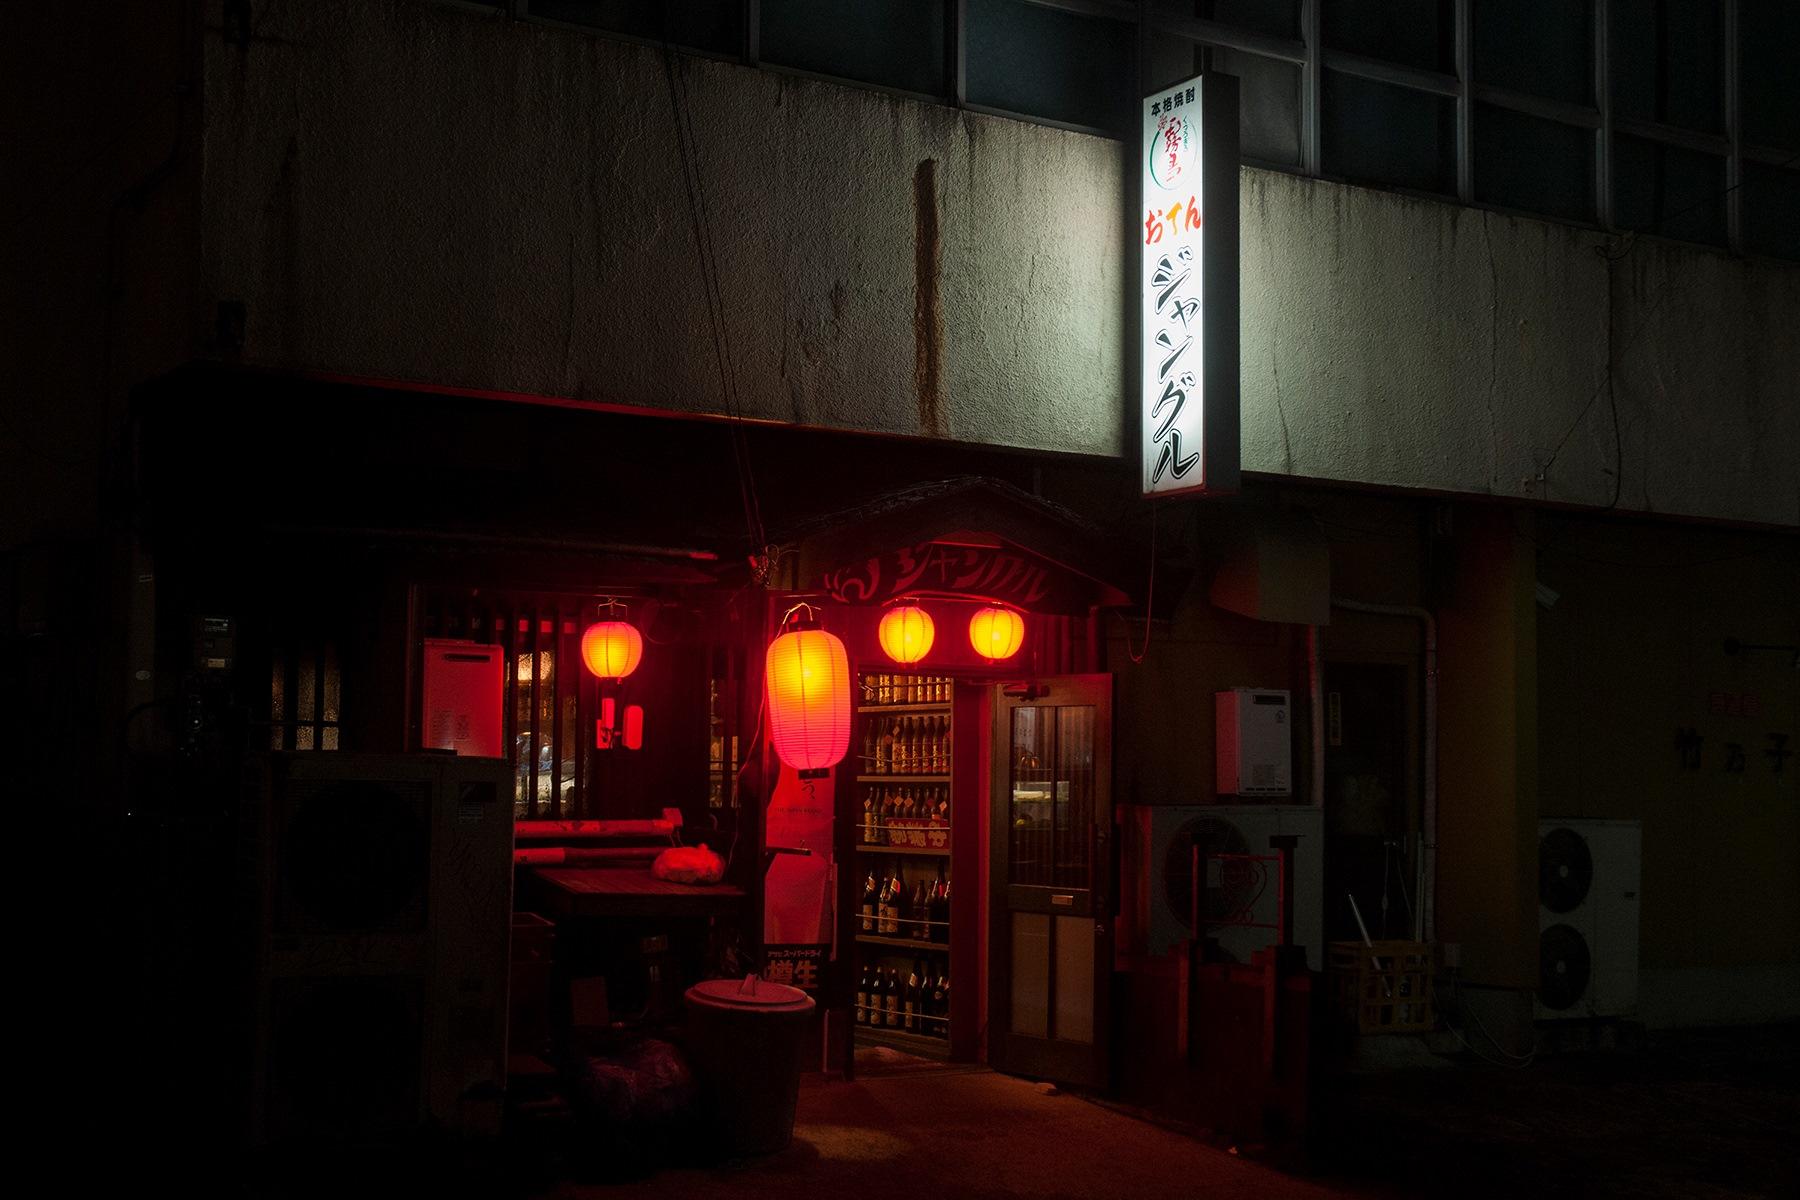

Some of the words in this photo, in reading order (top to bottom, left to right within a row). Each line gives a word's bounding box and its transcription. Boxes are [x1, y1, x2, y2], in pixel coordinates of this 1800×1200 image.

[1150, 86, 1196, 117] 本格焼酎
[1150, 244, 1200, 484] ジャングル
